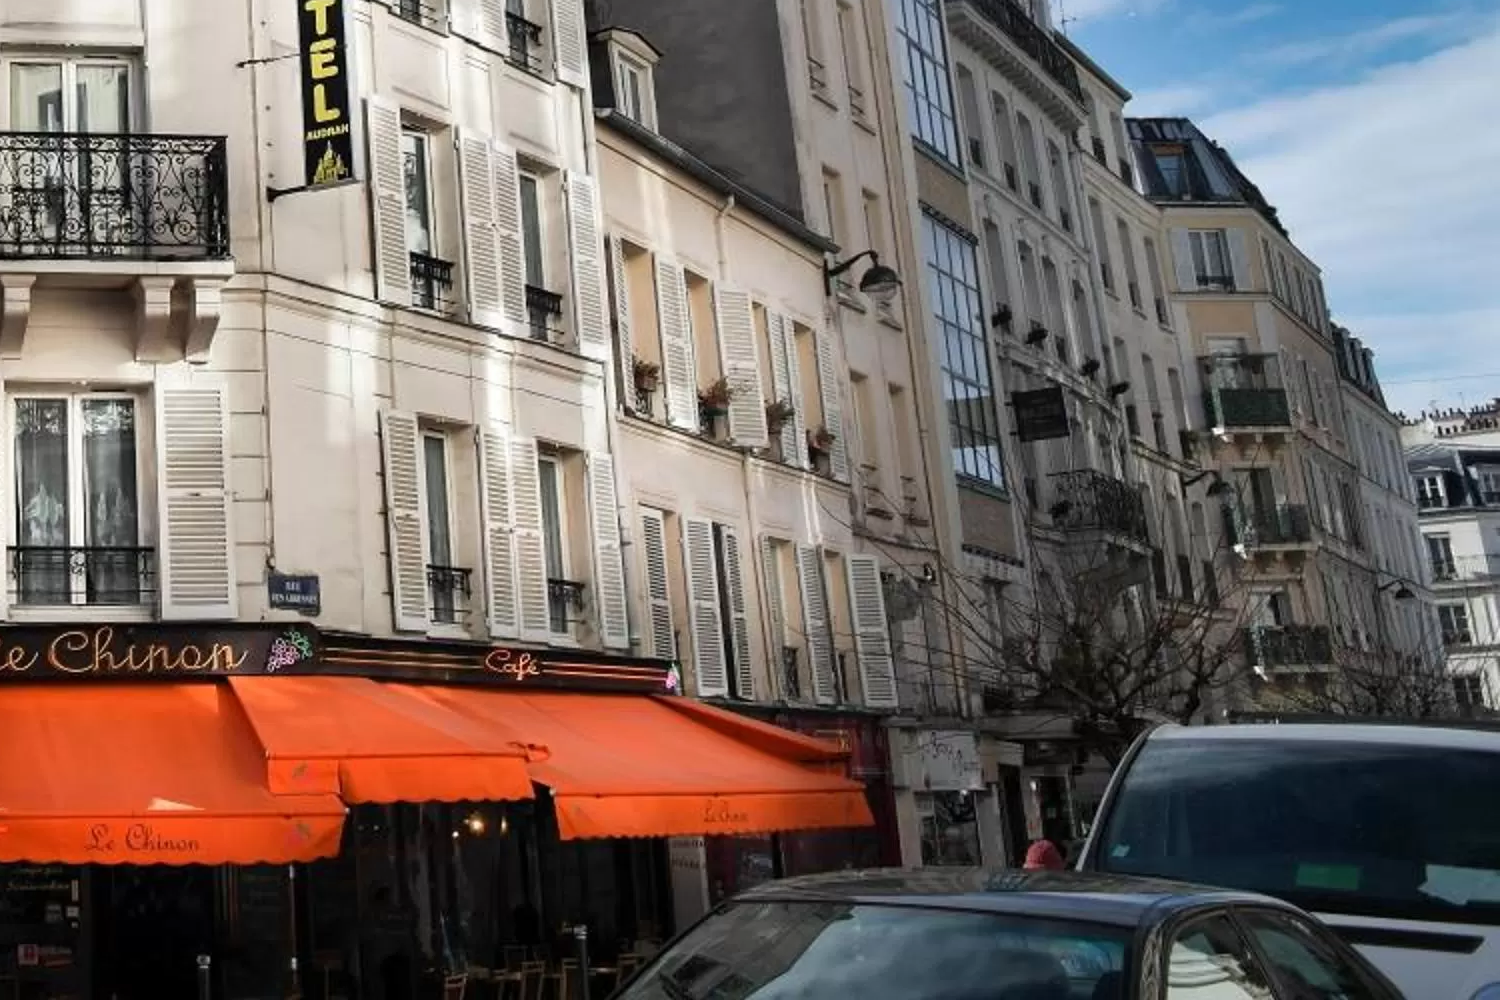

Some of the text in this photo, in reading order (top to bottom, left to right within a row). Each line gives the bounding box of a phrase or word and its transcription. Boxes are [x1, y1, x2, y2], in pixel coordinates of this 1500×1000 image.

[49, 625, 249, 673] Chinon
[485, 649, 540, 680] Café
[83, 823, 200, 852] Le Chinon
